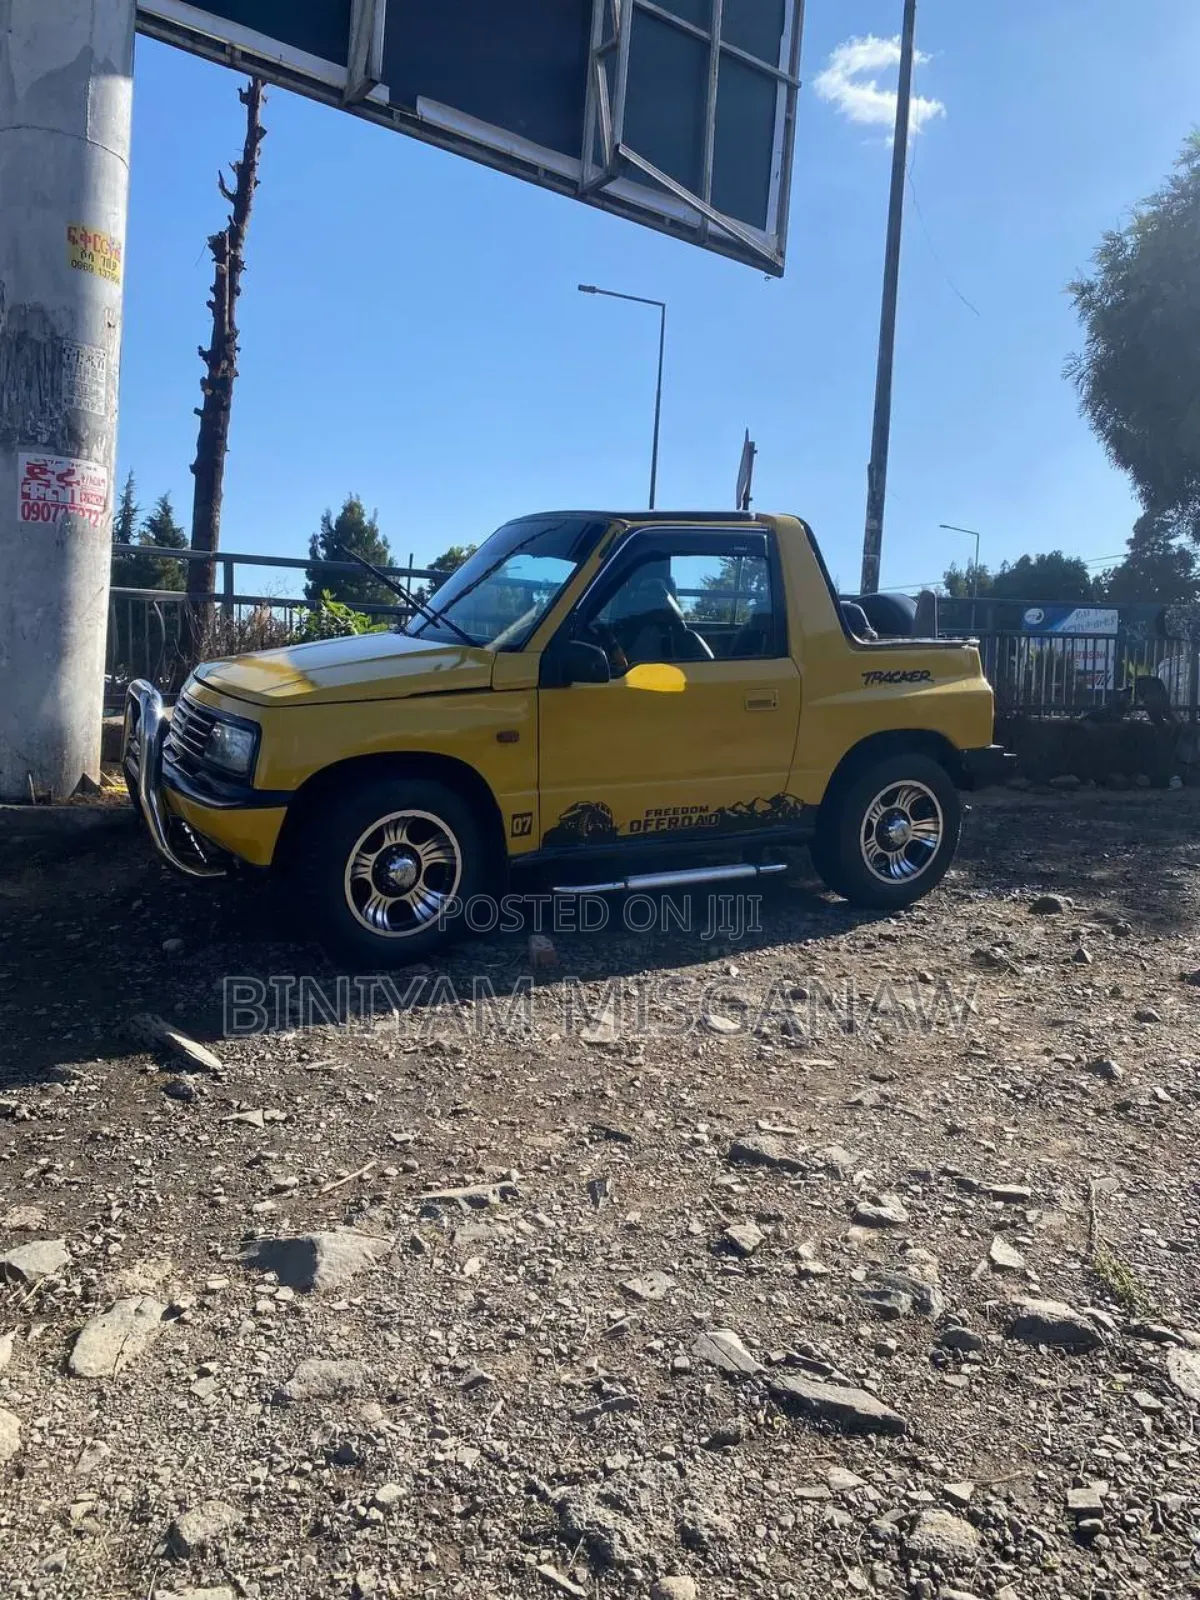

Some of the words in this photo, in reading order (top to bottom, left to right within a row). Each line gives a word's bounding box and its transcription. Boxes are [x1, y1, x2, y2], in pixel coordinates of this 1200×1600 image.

[861, 670, 935, 687] TRACKER
[645, 805, 709, 818] FREEDOM
[513, 816, 531, 834] 07
[629, 814, 720, 832] OFFROAD
